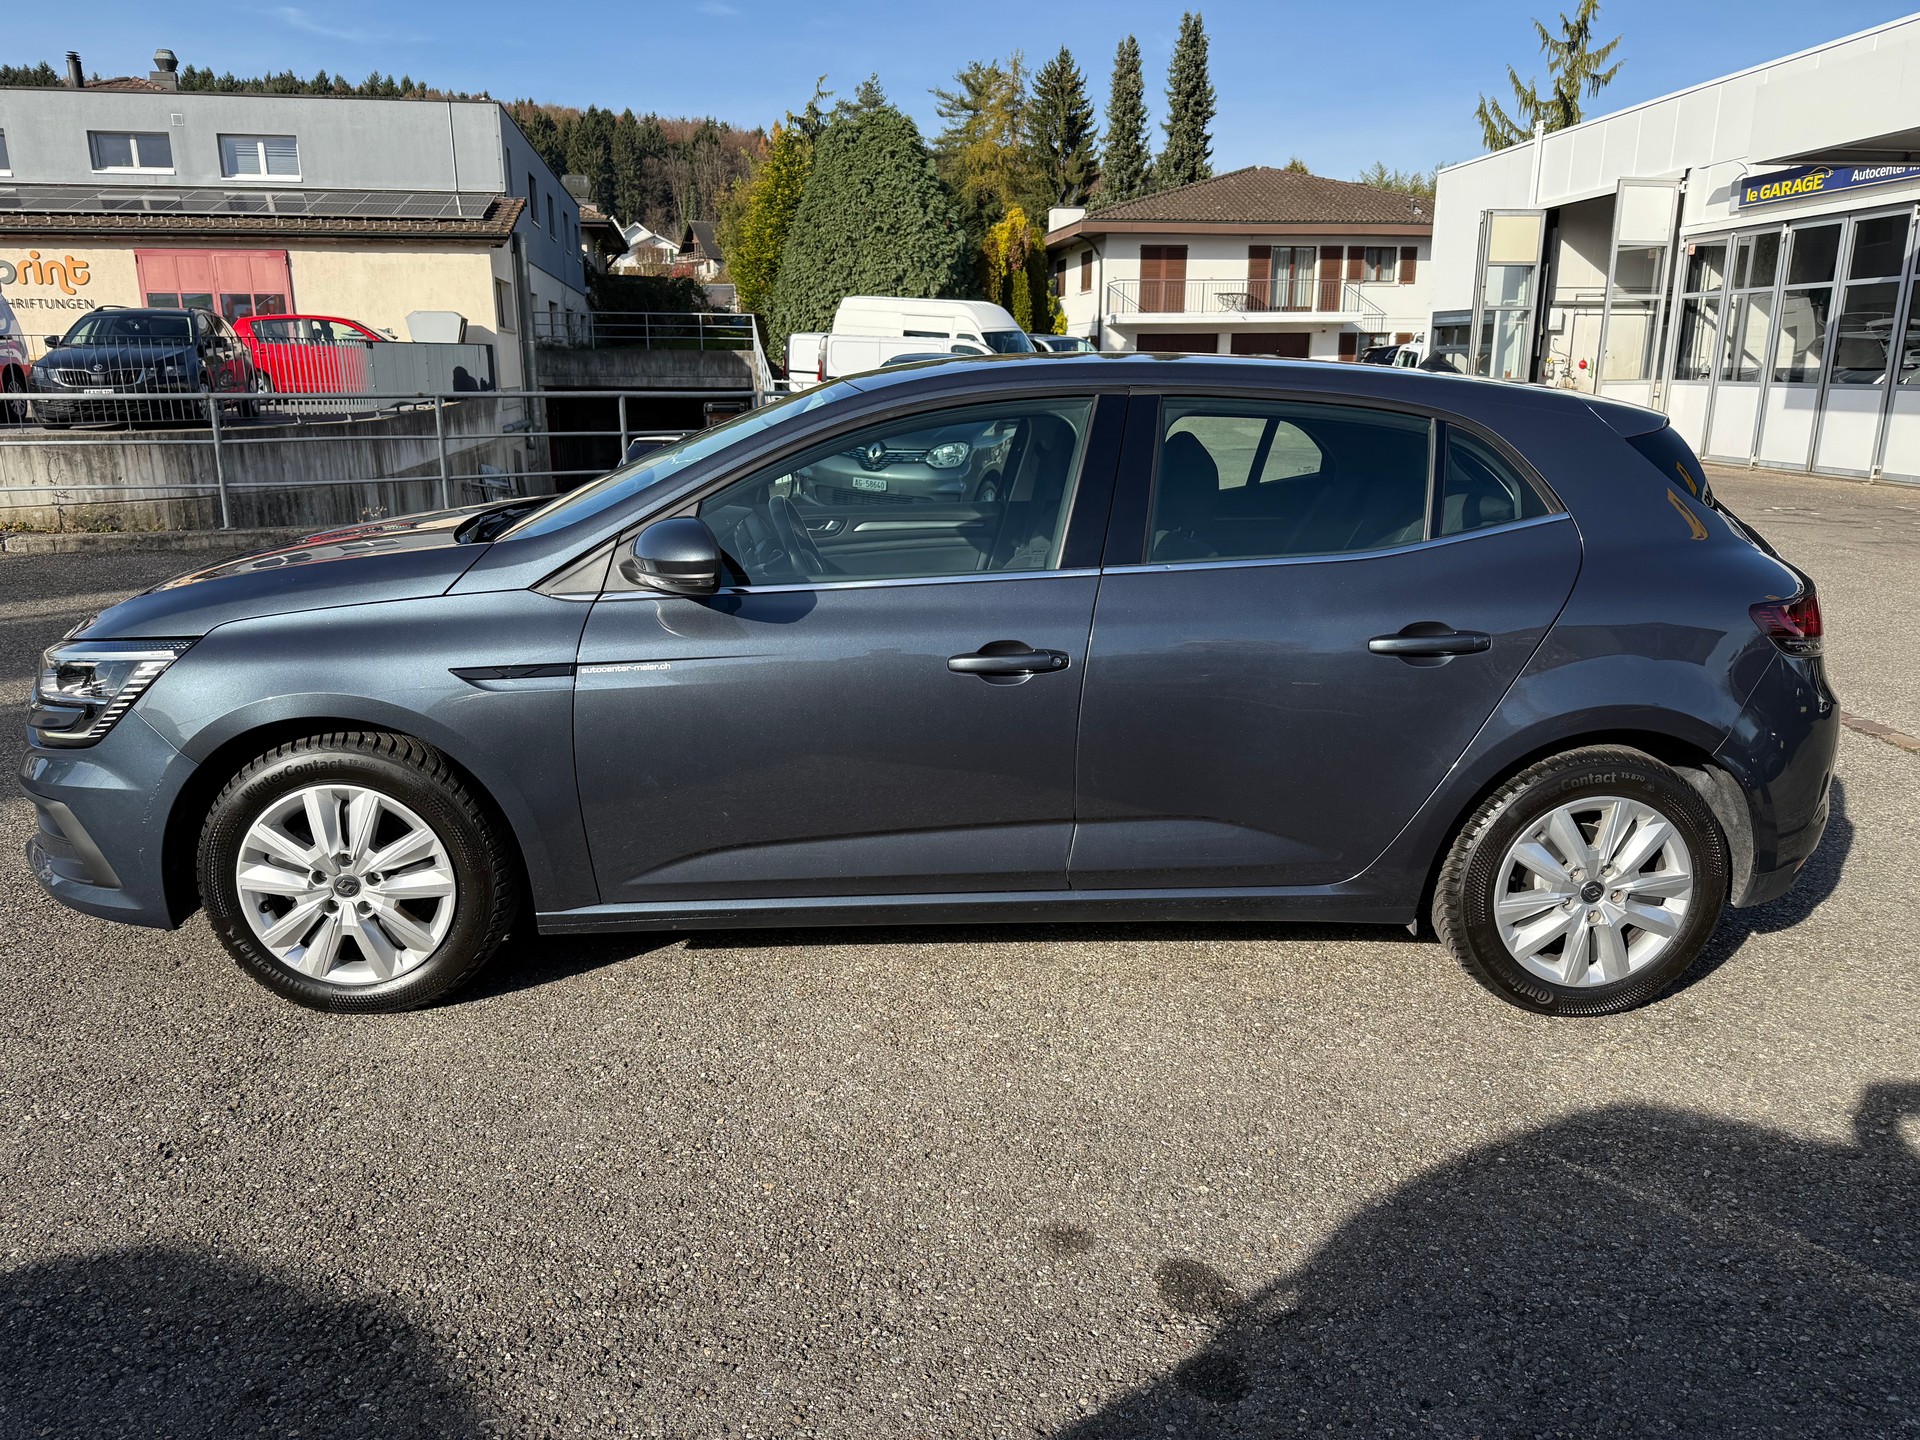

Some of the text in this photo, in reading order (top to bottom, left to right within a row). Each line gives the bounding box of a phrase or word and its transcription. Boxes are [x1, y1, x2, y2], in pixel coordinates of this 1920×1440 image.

[1745, 174, 1825, 202] le GARAGE
[241, 758, 344, 802] WinterContact
[1515, 771, 1646, 815] nterContact TS 870
